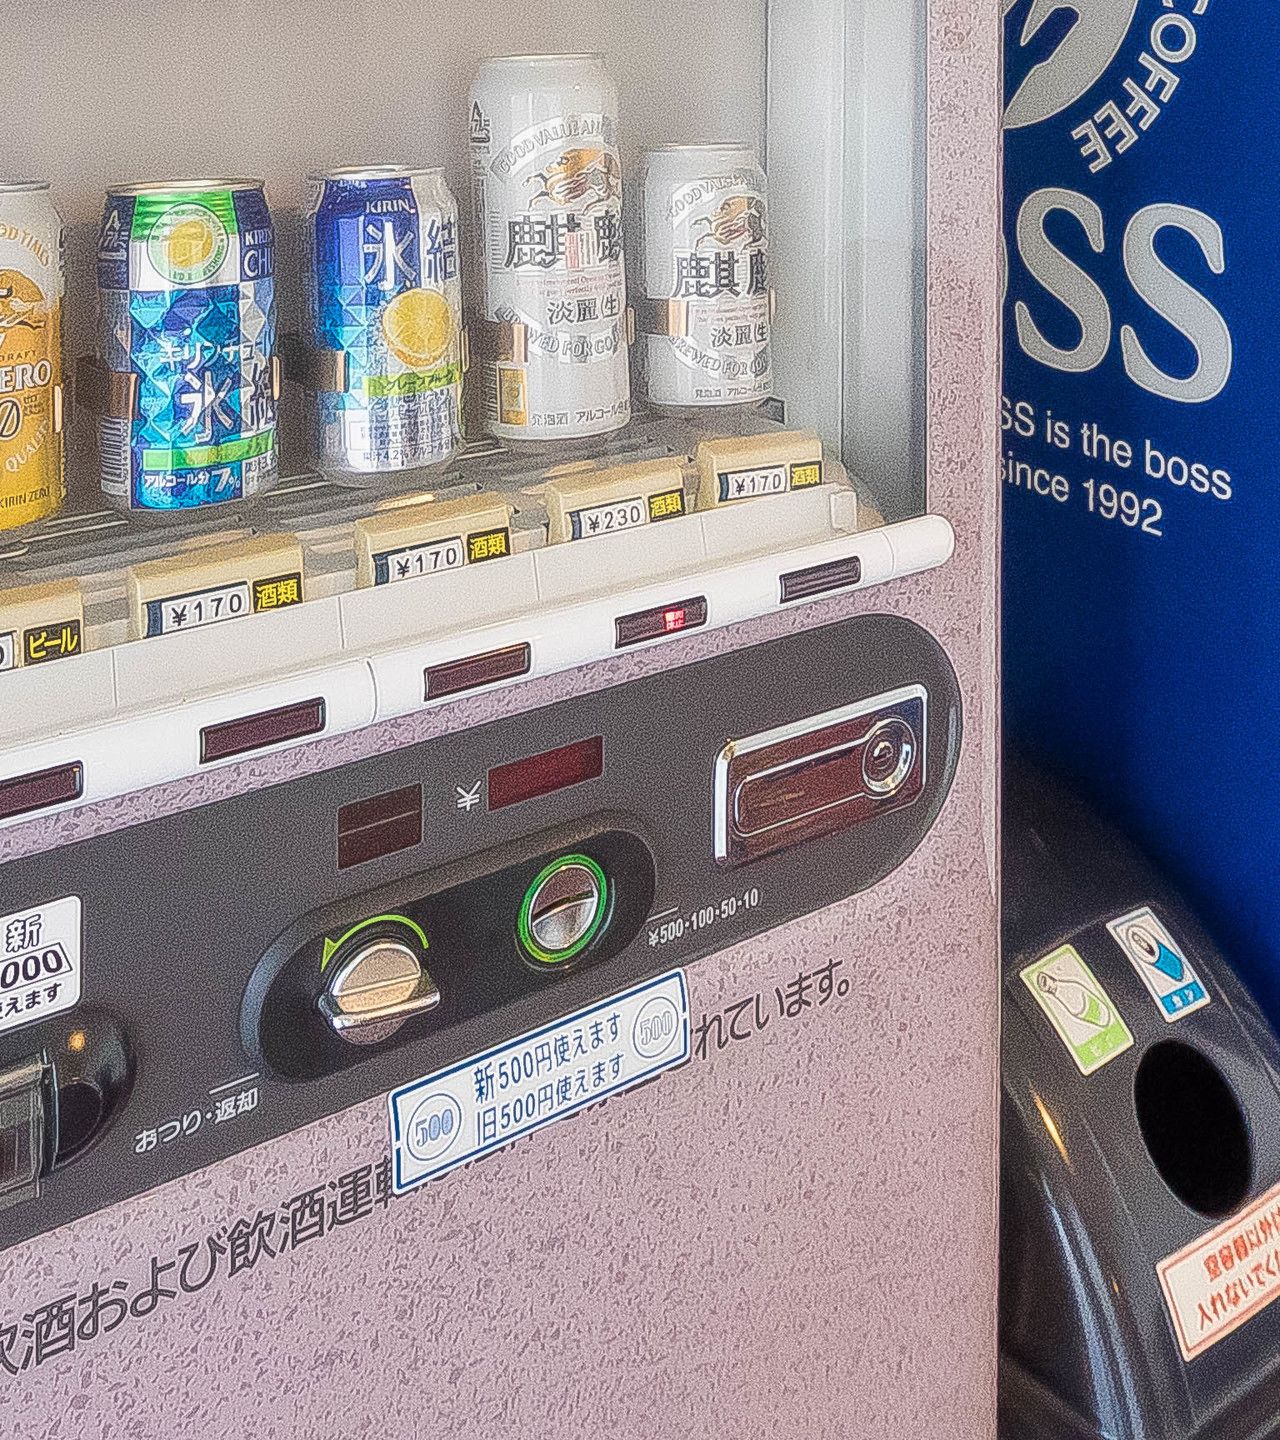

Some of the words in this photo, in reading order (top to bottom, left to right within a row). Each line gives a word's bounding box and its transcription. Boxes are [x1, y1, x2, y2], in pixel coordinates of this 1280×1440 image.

[366, 200, 412, 214] KIRIN
[361, 215, 459, 291] 氷結
[1003, 186, 1233, 404] SS
[1045, 410, 1071, 449] is
[1081, 422, 1133, 469] the
[1144, 439, 1233, 501] boss
[144, 469, 210, 489] アルコール分
[734, 471, 782, 495] ¥170
[792, 464, 821, 485] 酒類
[588, 502, 643, 533] ¥230
[649, 491, 683, 519] 酒類
[1081, 478, 1164, 538] 1992
[396, 545, 459, 577] ¥170
[469, 531, 508, 559] 酒類
[170, 591, 244, 627] ¥170
[255, 578, 300, 611] 酒類
[27, 627, 79, 660] ビール
[456, 781, 483, 811] ¥
[6, 913, 42, 954] 新
[637, 1009, 673, 1047] 500
[472, 1011, 622, 1106] 新500円使えます
[476, 1052, 625, 1147] 旧500円使えます
[413, 1105, 456, 1149] 500
